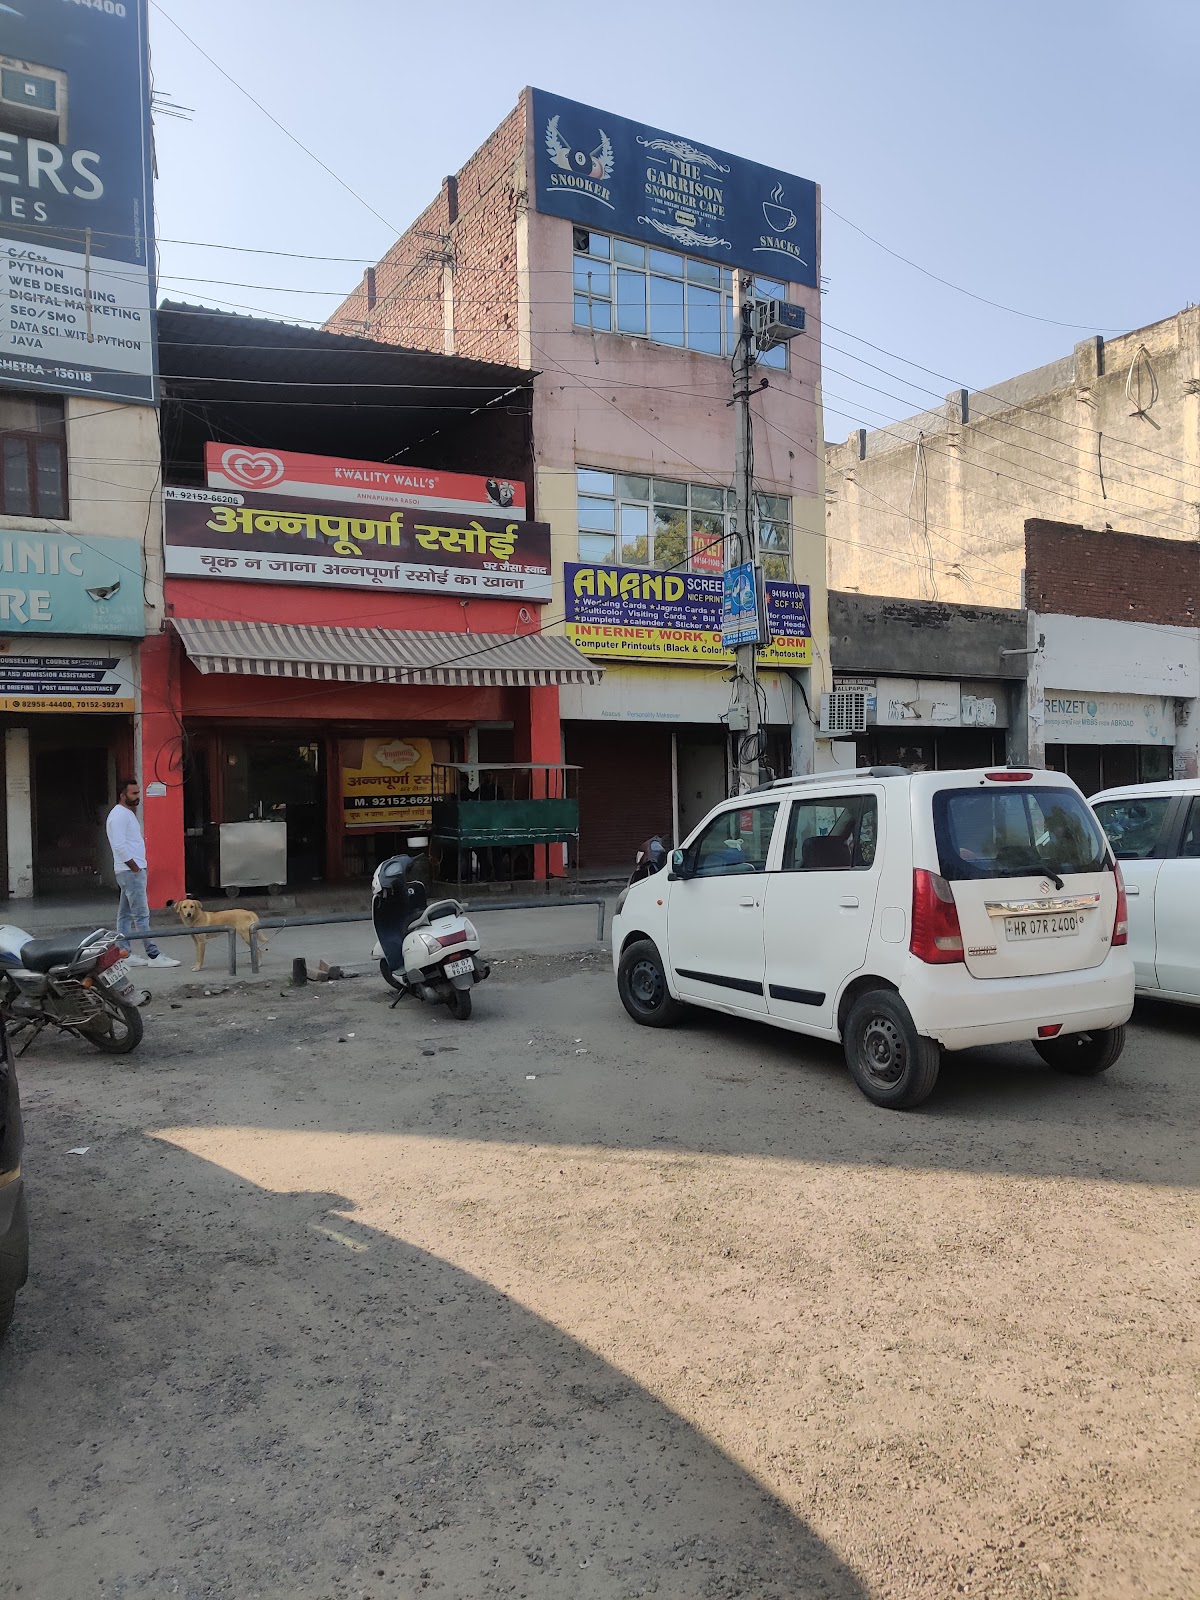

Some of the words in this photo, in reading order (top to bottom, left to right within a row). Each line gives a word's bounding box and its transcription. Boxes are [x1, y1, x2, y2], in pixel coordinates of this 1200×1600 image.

[669, 158, 701, 181] THE
[550, 173, 611, 201] SNOOKER
[646, 167, 723, 204] GARRISON
[645, 183, 697, 208] SNOOKER
[699, 200, 725, 216] CAFE
[8, 248, 47, 262] C/C++
[759, 235, 801, 257] SNACKS
[8, 260, 64, 279] PYTHON
[8, 275, 41, 290] WEB
[44, 281, 116, 303] DESIGNING
[9, 289, 62, 307] DIGITAL
[11, 305, 77, 324] SEO/SMO
[10, 335, 43, 349] JAVA
[11, 320, 39, 334] DATA
[42, 325, 62, 337] SCI.
[97, 334, 141, 351] PYTHON
[334, 467, 390, 484] KWALITY
[393, 474, 435, 489] WALL'S
[166, 490, 178, 498] M.
[180, 491, 239, 505] 92152-66206
[356, 493, 399, 503] ANNAPURNA
[400, 496, 420, 505] RASOI
[205, 505, 404, 555] अन्नपूर्णा
[413, 520, 518, 560] रसोई
[692, 536, 705, 555] TO
[707, 538, 722, 557] LET
[200, 554, 239, 573] चूक
[244, 558, 262, 570] न
[267, 559, 317, 574] जाना
[322, 562, 400, 583] अन्नपूर्णा
[405, 567, 449, 585] रसोई
[453, 573, 477, 586] का
[482, 576, 525, 589] खाना
[482, 561, 497, 571] घर
[499, 560, 522, 573] जैसा
[524, 565, 548, 575] स्वाद
[573, 568, 685, 602] ANAND
[622, 601, 647, 610] Cards
[655, 604, 683, 613] Jagran
[684, 606, 708, 614] Cards
[687, 593, 704, 602] NICE
[774, 599, 790, 608] SCF
[580, 606, 623, 616] Multicolor
[628, 609, 659, 620] Visiting
[663, 612, 687, 621] Cards
[783, 620, 806, 628] Heads
[581, 616, 621, 624] pumplets
[629, 618, 664, 628] calender
[675, 621, 703, 629] Sticker
[786, 628, 805, 636] Work
[575, 624, 654, 639] INTERNET
[659, 629, 708, 645] WORK,
[575, 638, 619, 649] Computer
[621, 641, 661, 651] Printouts
[663, 643, 690, 653] (Black
[692, 645, 698, 653] &
[770, 648, 806, 659] Photostat
[600, 710, 621, 718] Abacus
[626, 710, 656, 719] Personality
[1110, 719, 1134, 727] ABROAD
[347, 772, 410, 790] अन्नपूर्णा
[354, 798, 369, 807] M.
[1014, 921, 1028, 936] HR
[1051, 916, 1076, 933] 2400
